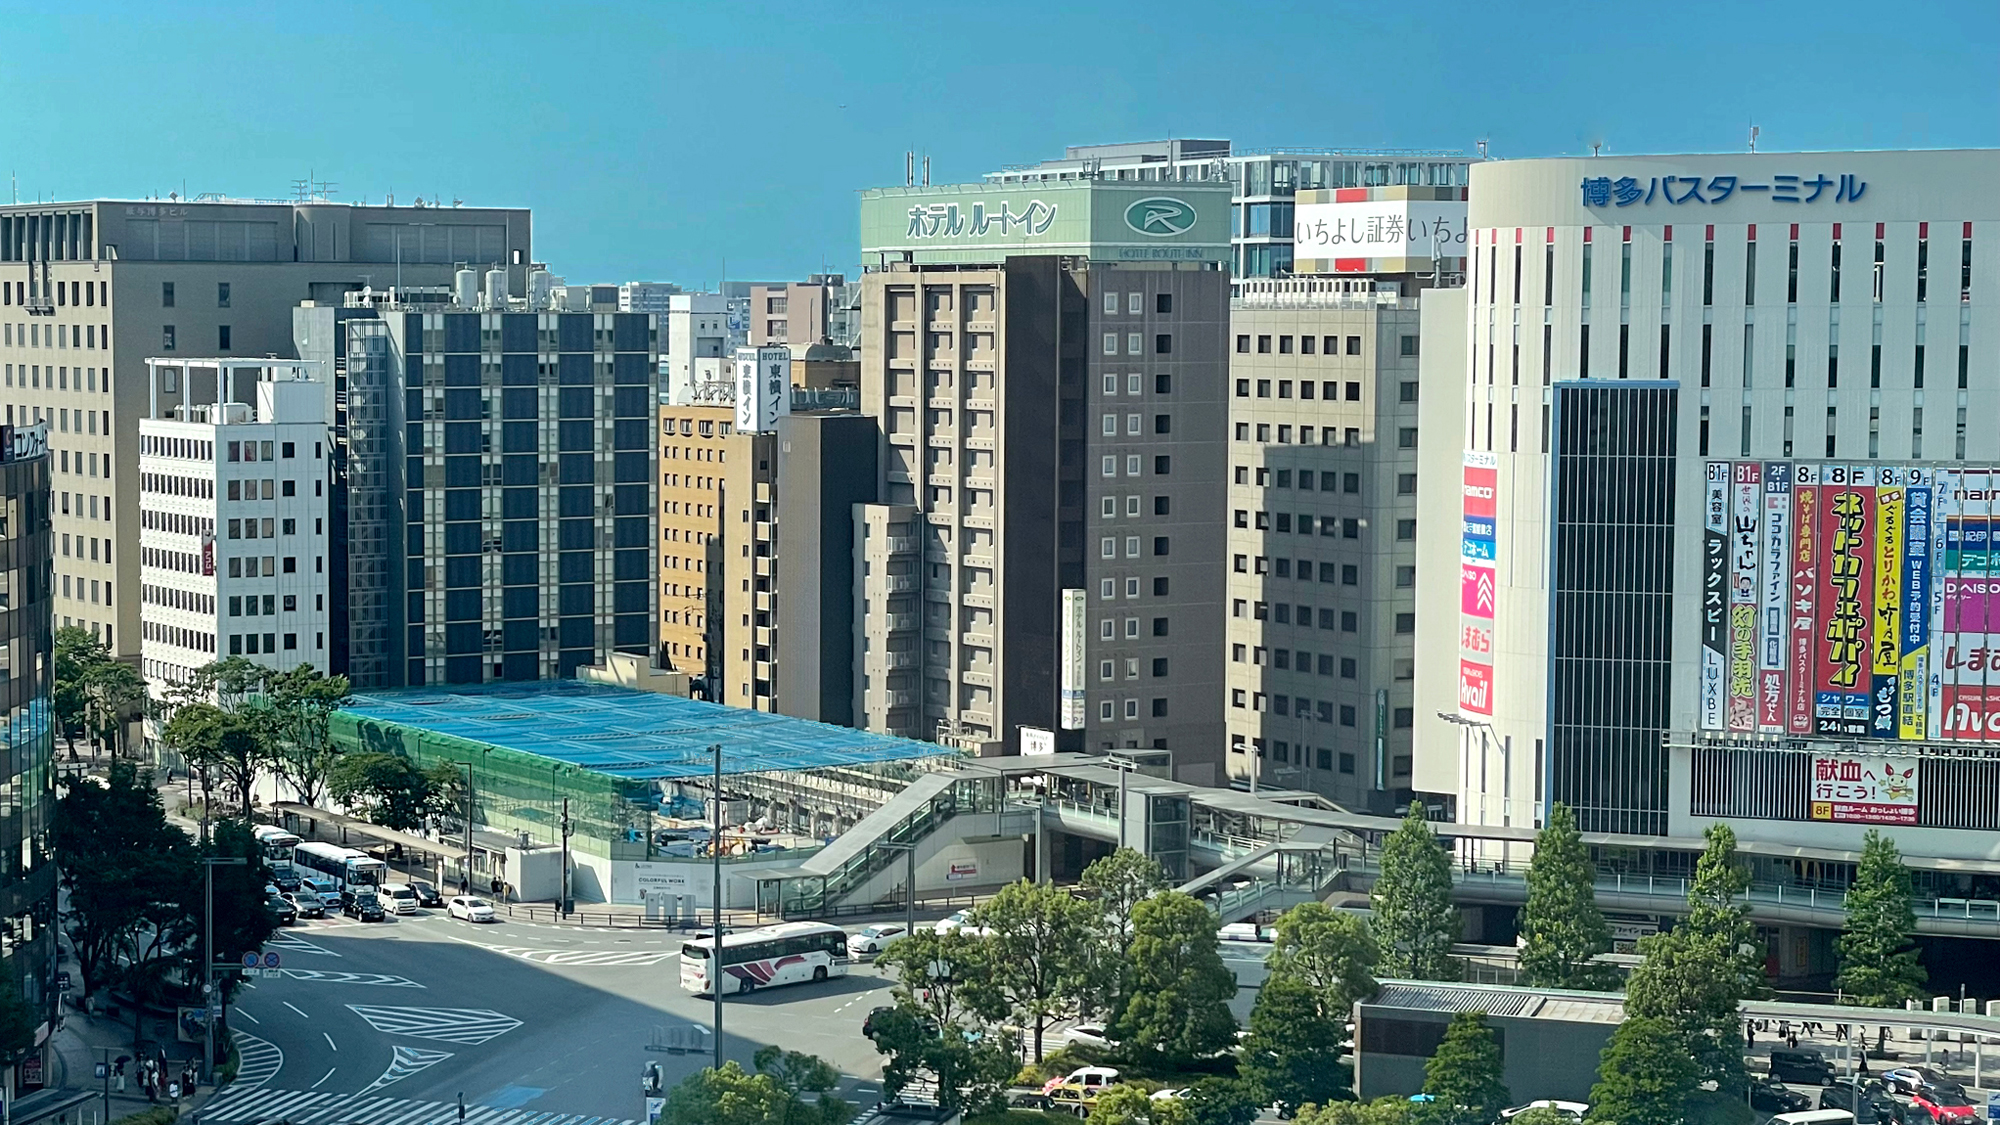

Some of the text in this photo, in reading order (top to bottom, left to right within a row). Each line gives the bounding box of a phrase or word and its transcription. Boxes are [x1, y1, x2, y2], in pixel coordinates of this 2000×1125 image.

[1581, 173, 1867, 207] 博多バスターミナル
[906, 200, 1057, 238] ホテル ルートイン
[1296, 214, 1404, 245] いちよし証券
[1185, 247, 1203, 259] INN
[762, 352, 788, 361] HOTEL
[769, 363, 782, 425] 東横イン
[1708, 464, 1727, 481] B1F
[1737, 465, 1759, 482] B1F
[1771, 465, 1786, 476] 2F
[1797, 466, 1817, 483] 8F
[1831, 467, 1865, 484] 8F
[1881, 469, 1900, 485] 8F
[1910, 469, 1930, 486] 9F
[1767, 481, 1788, 492] B1F
[1908, 491, 1928, 556] 貸会議室
[1736, 515, 1756, 570] 山ちゃん
[1769, 513, 1782, 602] ココカラファイン
[1881, 505, 1897, 600] ぐるぐるとりかわ
[1706, 539, 1723, 641] ラックスビー
[1827, 491, 1867, 688] ネットカフェポパイ
[1731, 604, 1757, 697] 幻の手羽先
[1460, 675, 1488, 708] Avail
[1707, 652, 1718, 725] LUXBE
[1764, 673, 1780, 721] 処方せん
[1821, 693, 1865, 702] シャワー
[1902, 669, 1915, 726] 博多駅直結
[1816, 758, 1876, 782] 献血へ
[1816, 783, 1876, 800] 行こう!
[1815, 805, 1830, 816] 8F
